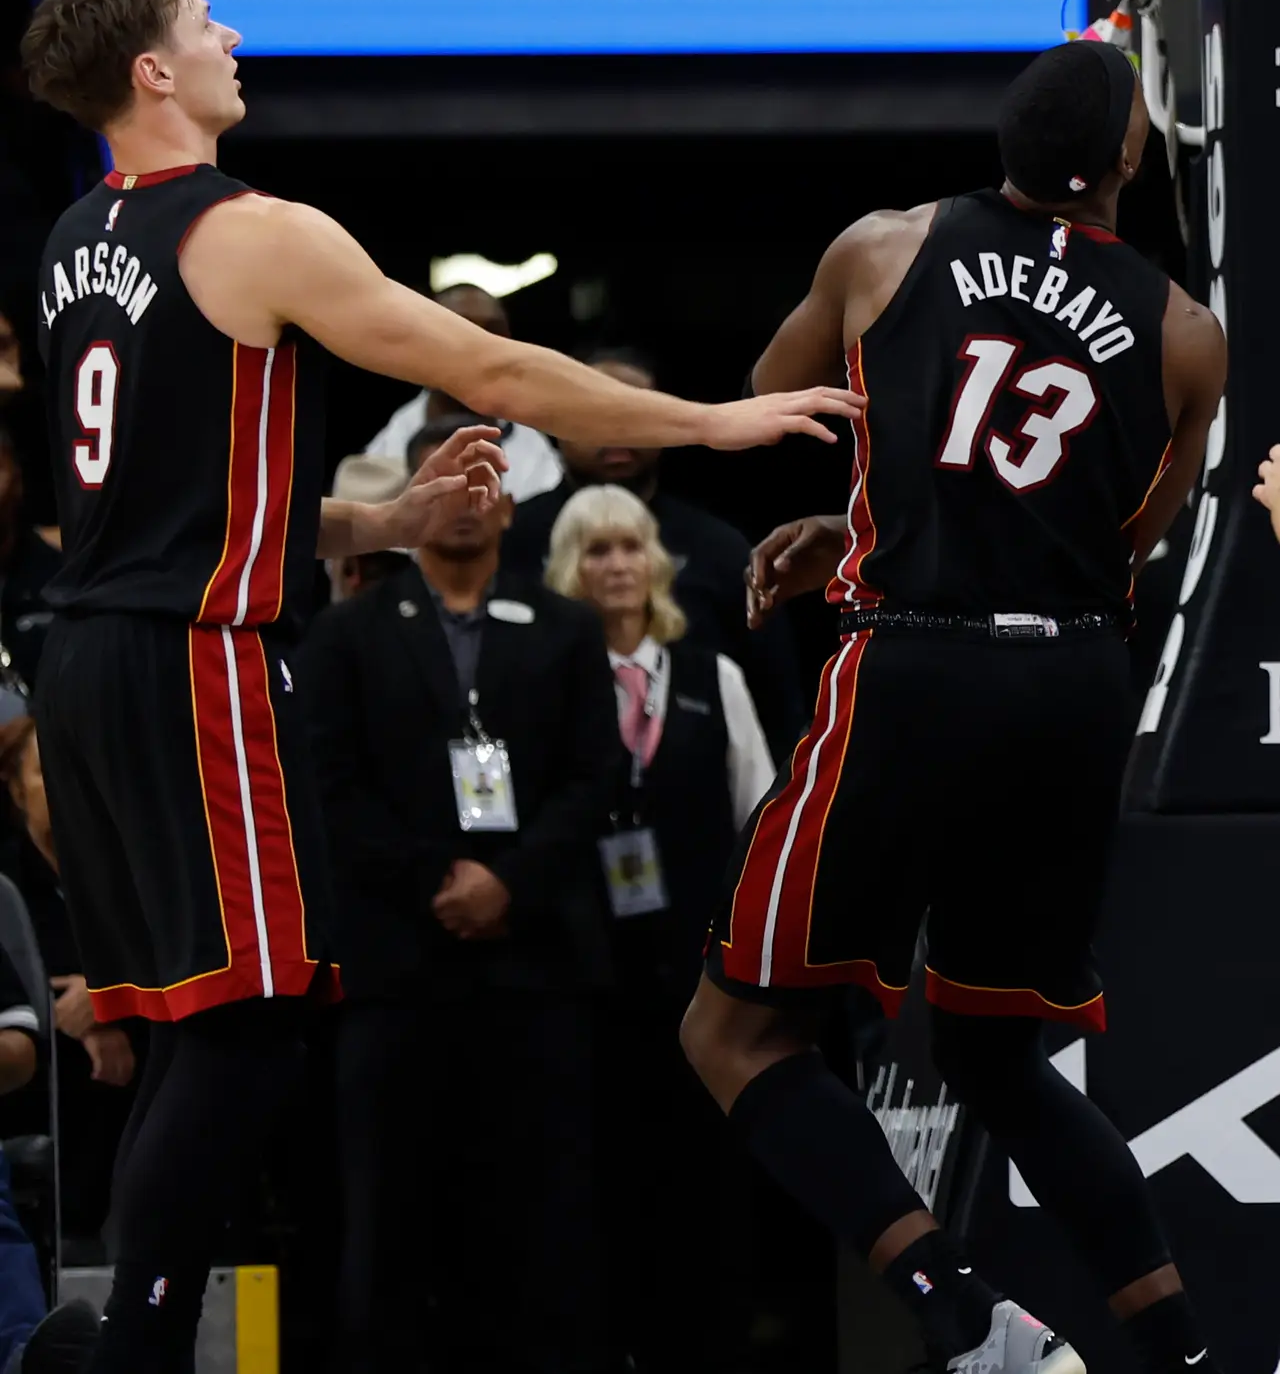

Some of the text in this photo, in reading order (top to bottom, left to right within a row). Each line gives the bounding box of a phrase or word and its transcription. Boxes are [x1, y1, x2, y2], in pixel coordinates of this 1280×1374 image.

[41, 241, 159, 331] LARSSON
[949, 251, 1137, 365] ADEBAYO
[72, 339, 122, 491] 9
[934, 333, 1103, 494] 13
